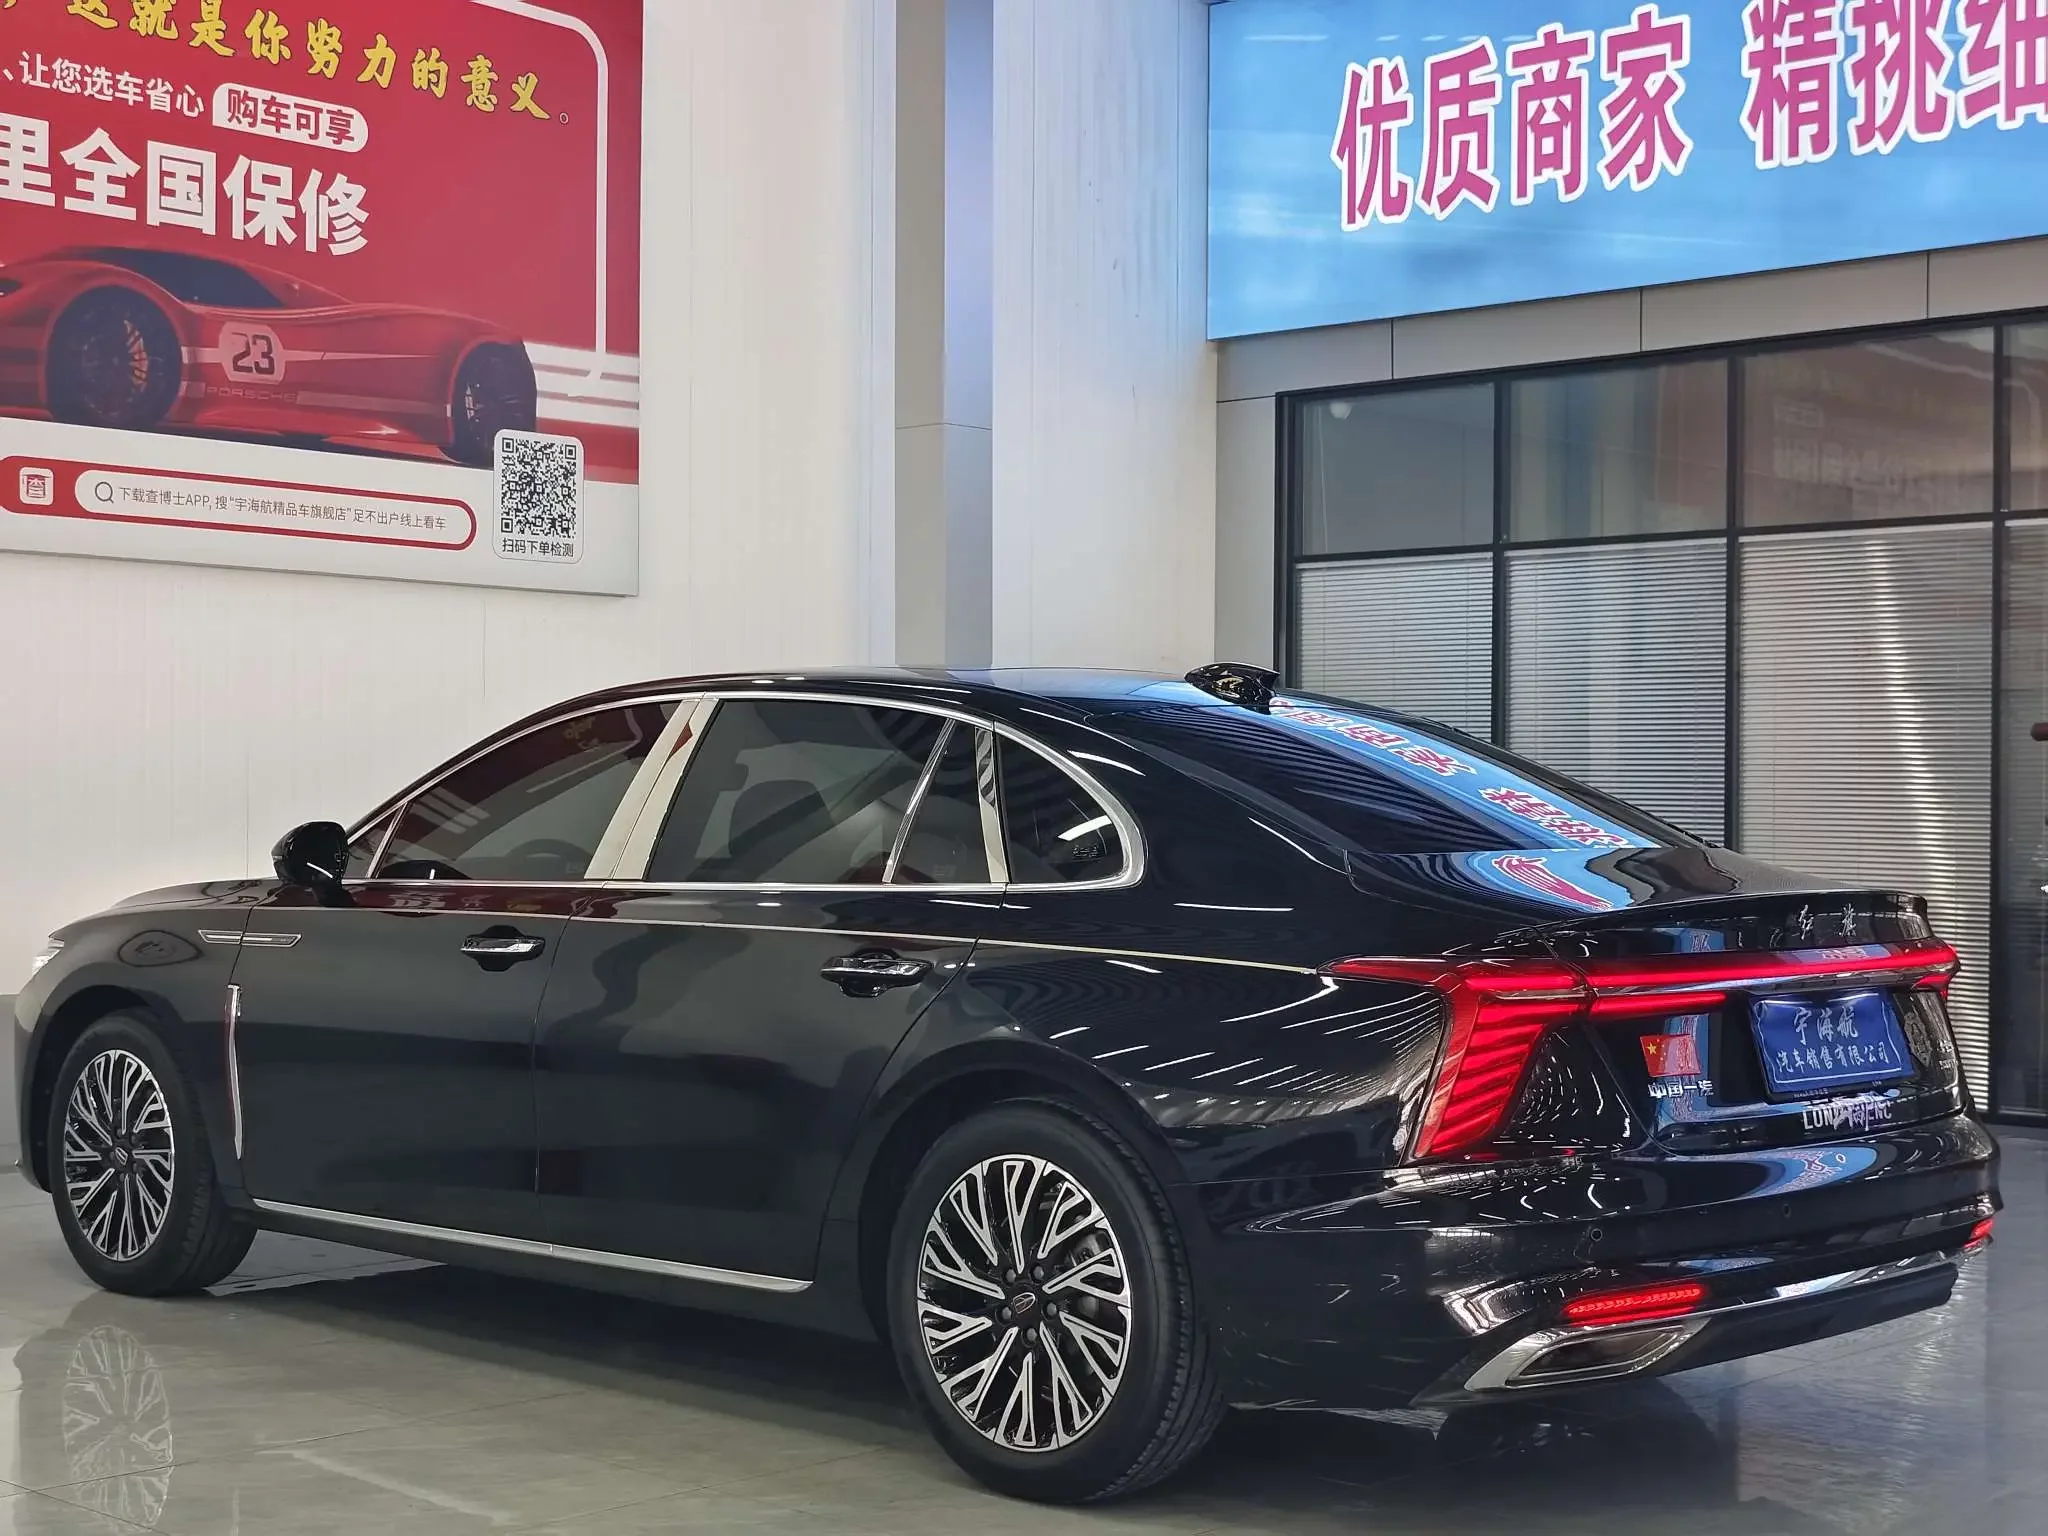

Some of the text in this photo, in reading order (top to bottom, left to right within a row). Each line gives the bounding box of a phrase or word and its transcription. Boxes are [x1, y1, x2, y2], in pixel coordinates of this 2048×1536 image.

[227, 89, 355, 146] 购车可享
[1332, 4, 1694, 230] 优质商家
[0, 112, 369, 257] 里全国保修
[231, 331, 275, 375] 23
[501, 537, 574, 557] 扫码下单检测
[1776, 1041, 1889, 1073] 汽车销售有限公司
